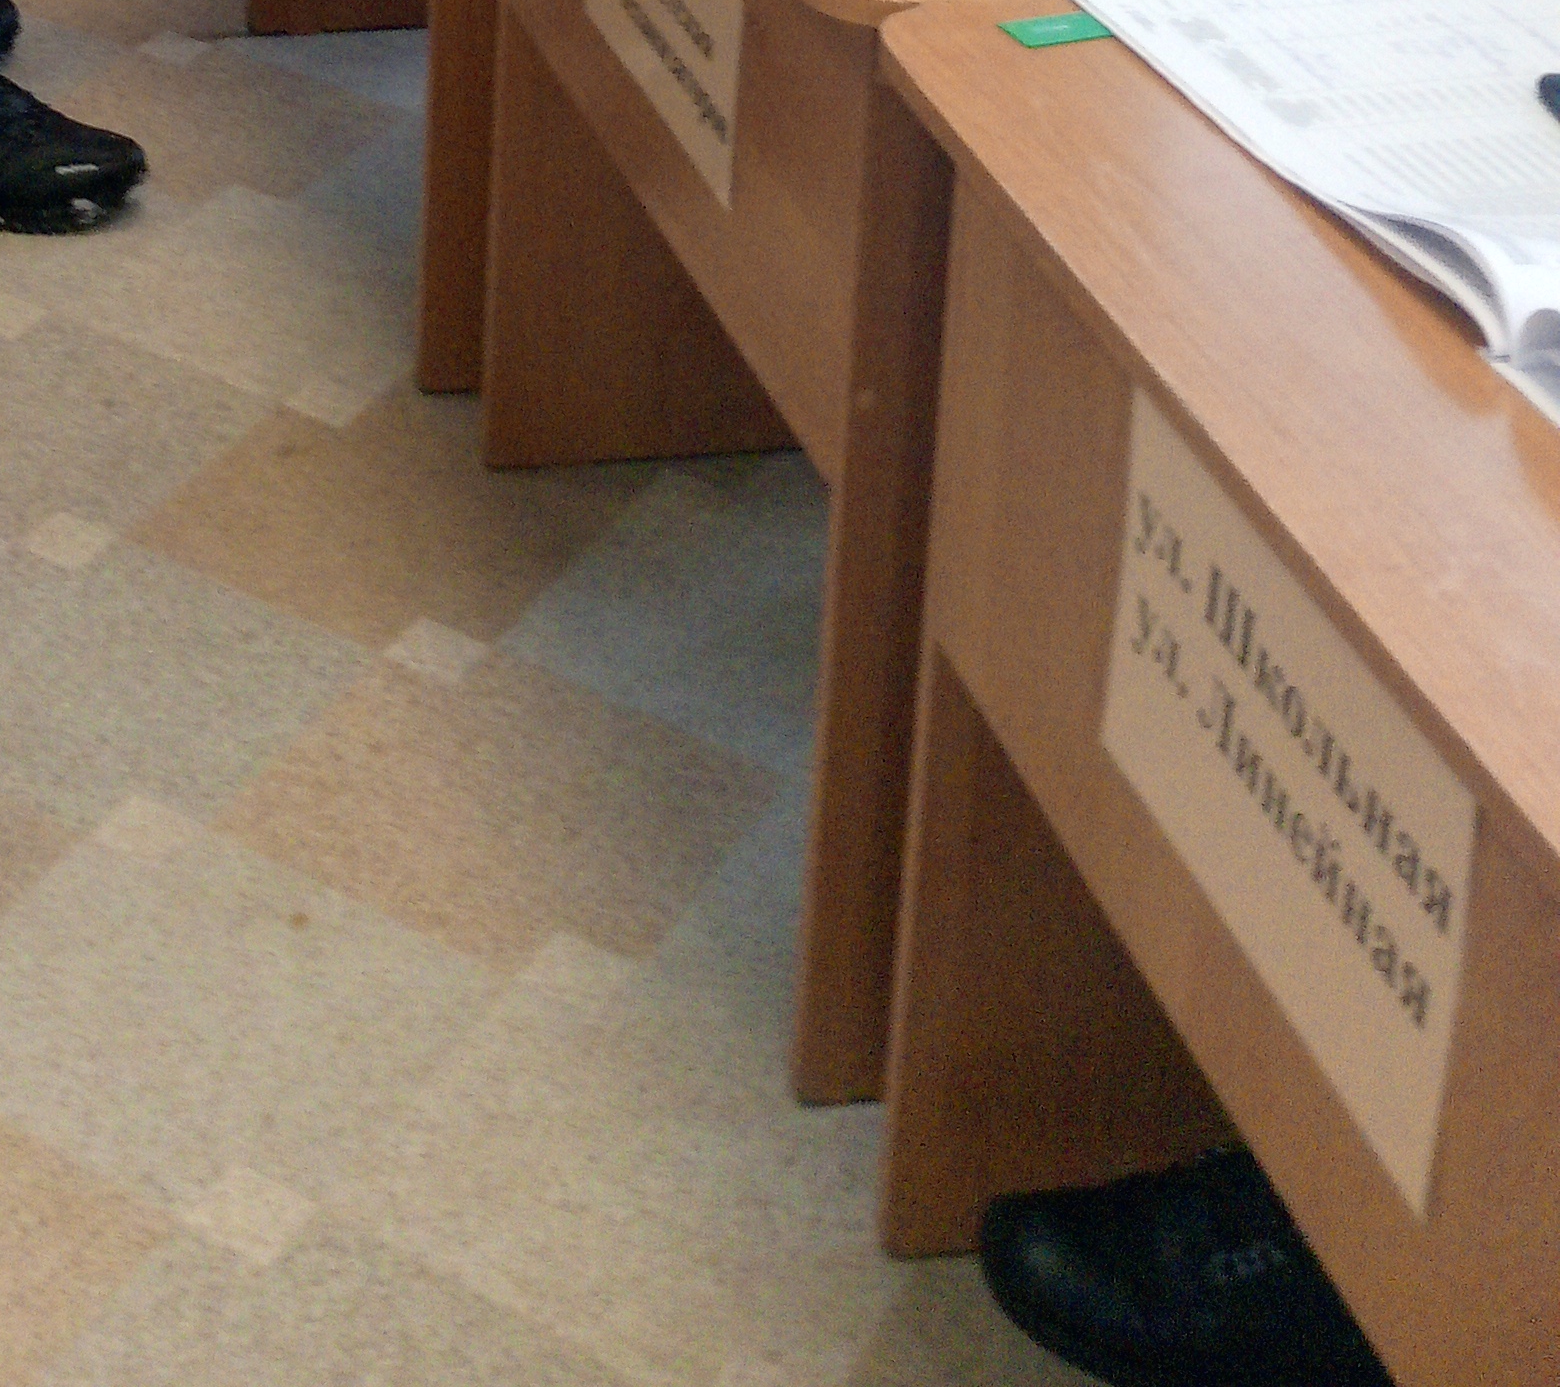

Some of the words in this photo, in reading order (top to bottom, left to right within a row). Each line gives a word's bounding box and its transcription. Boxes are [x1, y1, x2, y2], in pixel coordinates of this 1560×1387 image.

[1131, 593, 1190, 701] ул.
[1195, 676, 1432, 1030] Линейная
[1132, 489, 1193, 595] ул.
[1203, 563, 1453, 935] Школьная
